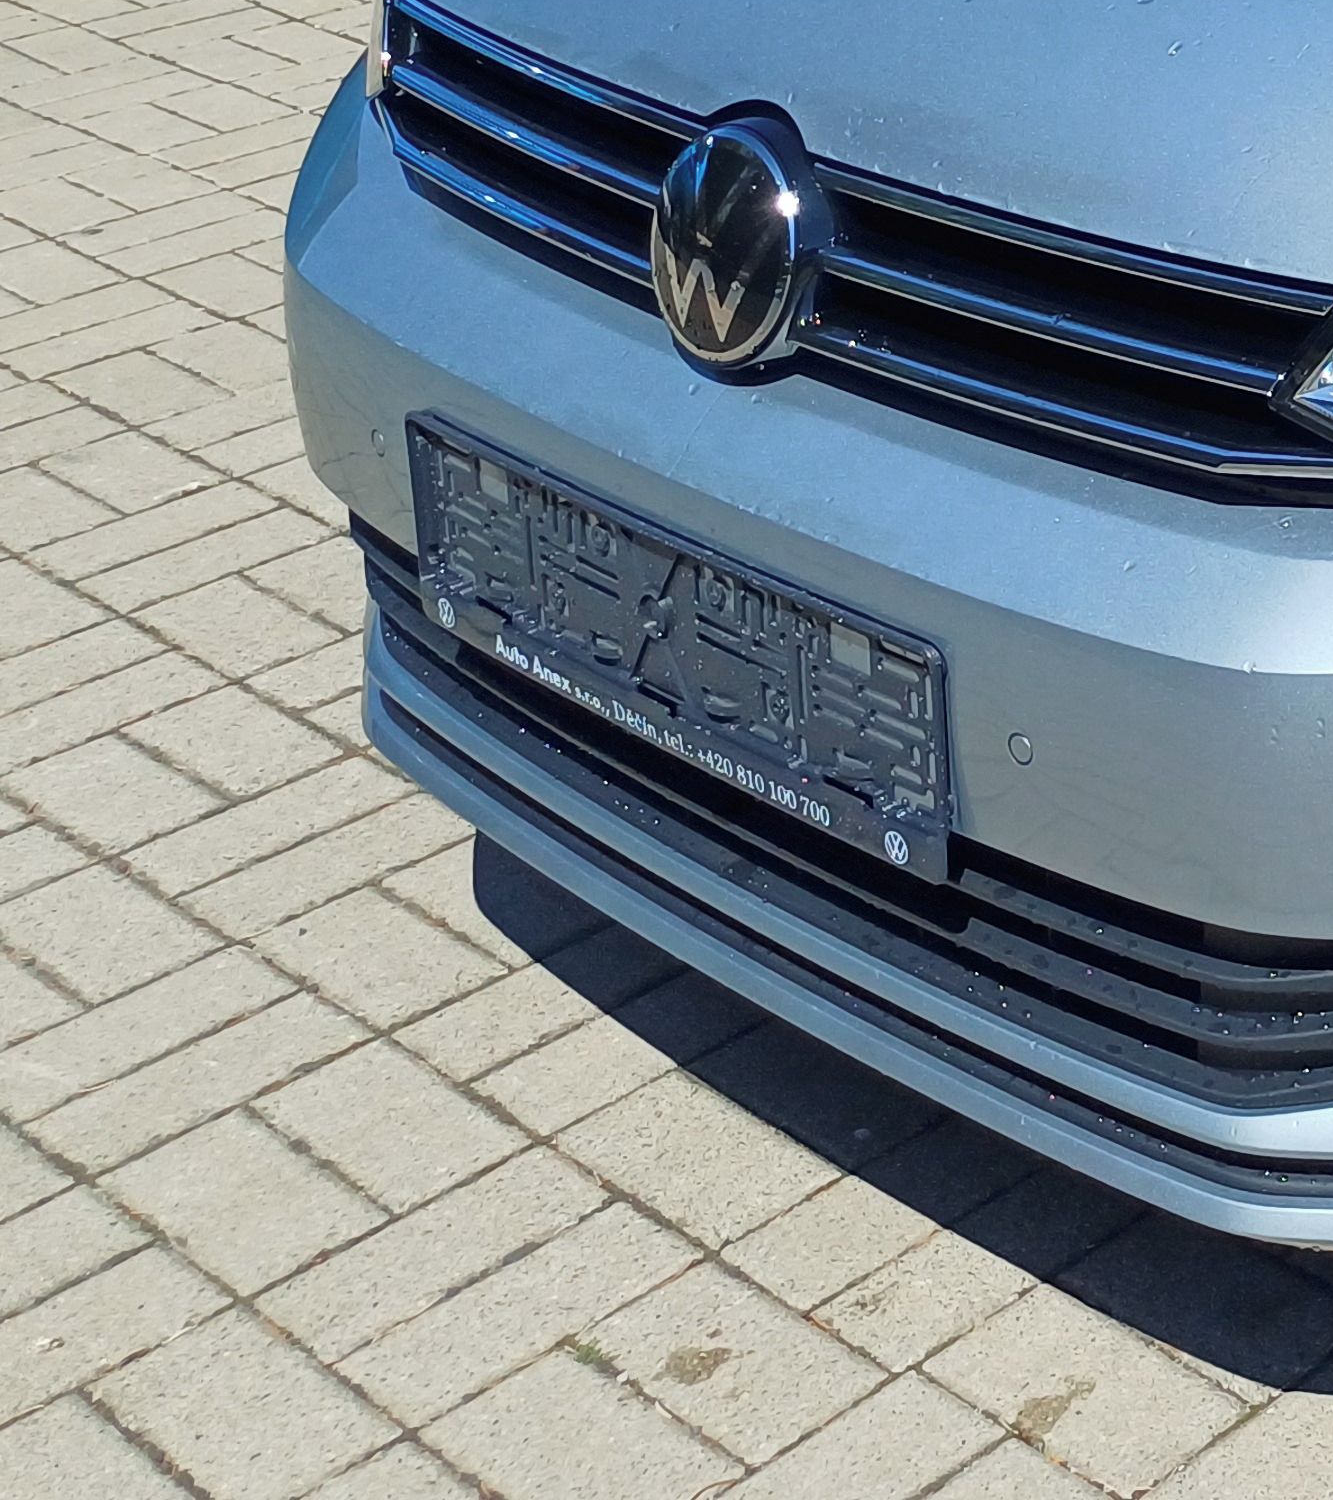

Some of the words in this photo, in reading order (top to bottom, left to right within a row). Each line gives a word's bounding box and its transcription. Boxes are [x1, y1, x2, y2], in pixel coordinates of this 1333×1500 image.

[495, 634, 529, 670] Auto
[532, 655, 571, 694] Anex
[611, 699, 663, 745] Děčín,
[697, 748, 734, 779] +420
[736, 765, 765, 794] 810
[768, 780, 797, 810] 100
[800, 796, 830, 827] 700
